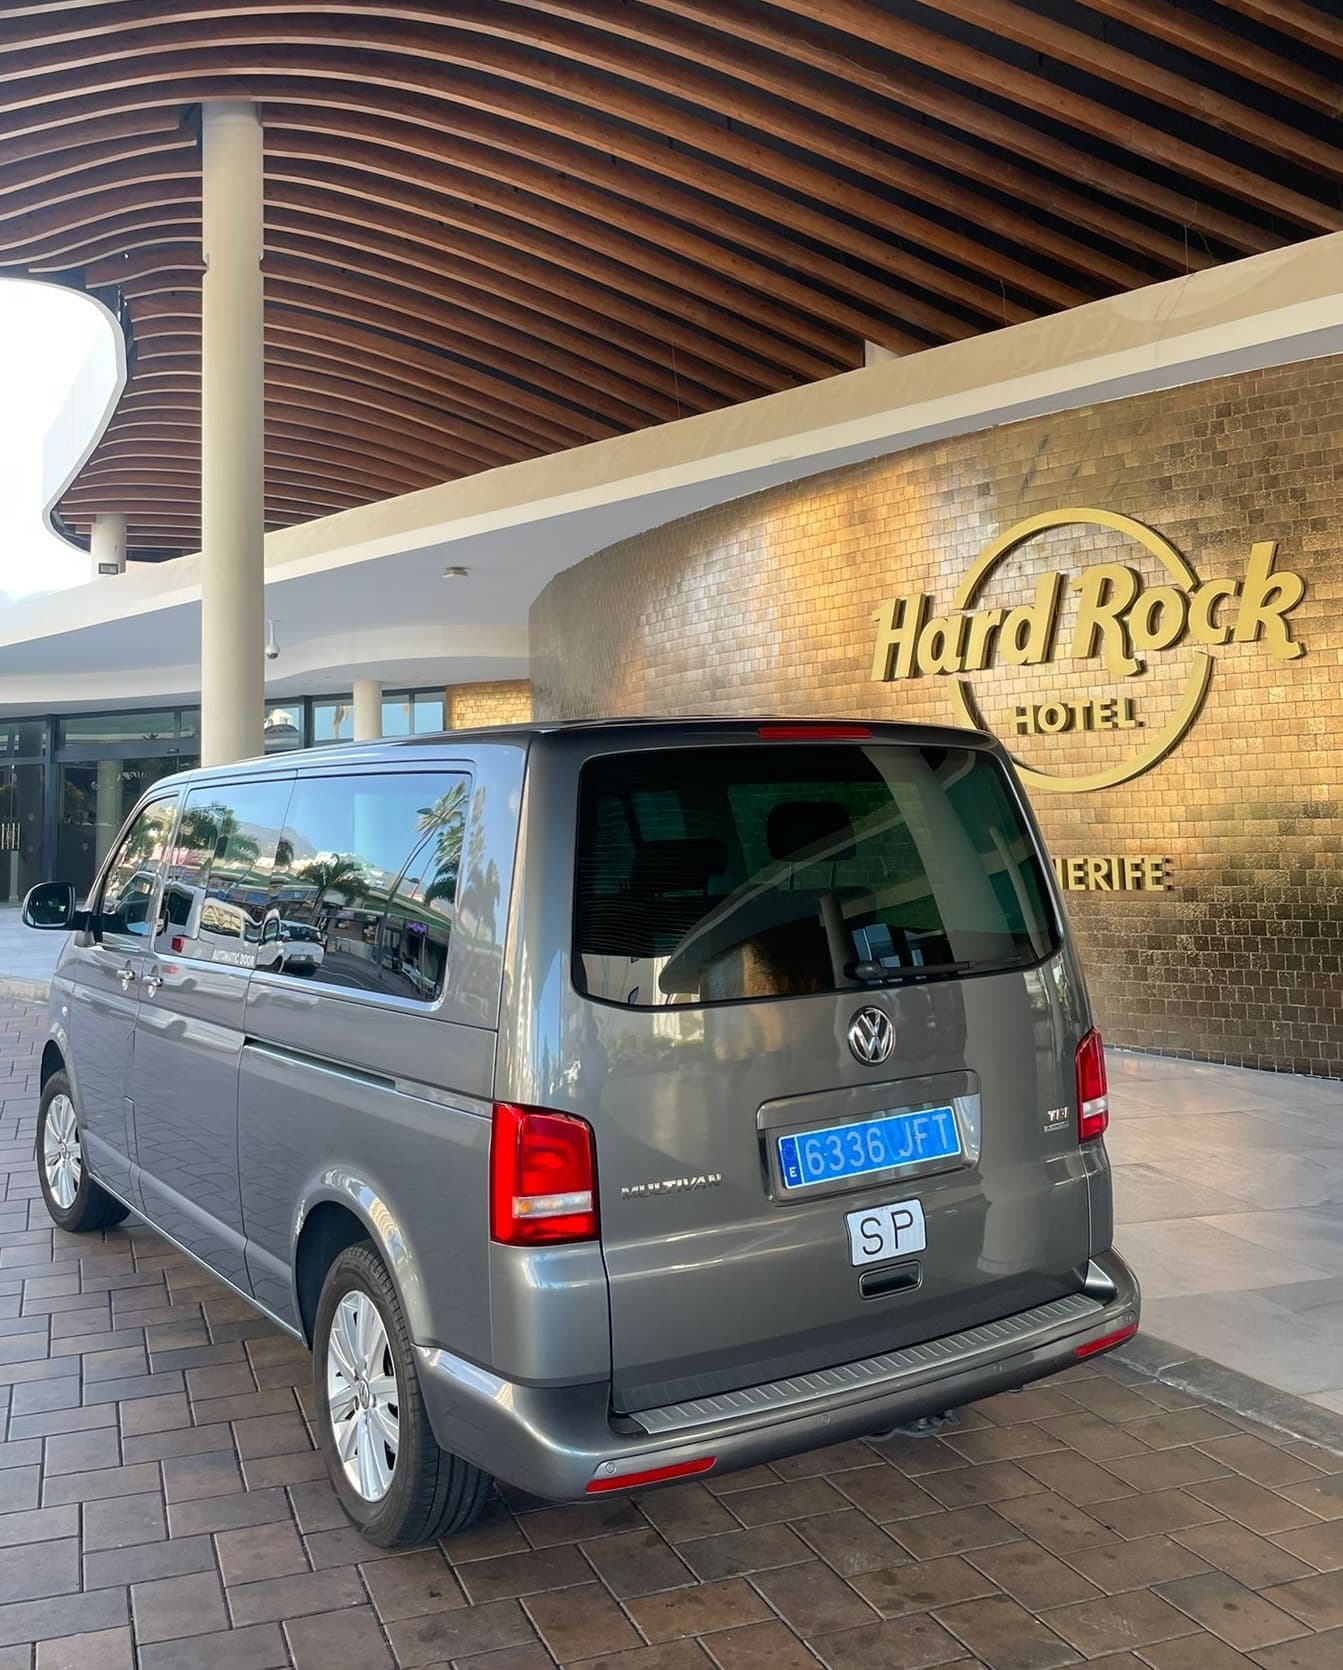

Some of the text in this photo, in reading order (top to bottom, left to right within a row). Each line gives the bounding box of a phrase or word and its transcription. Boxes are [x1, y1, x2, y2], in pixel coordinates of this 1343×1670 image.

[871, 541, 1306, 681] Hard Rock
[1009, 697, 1138, 735] HOTEL
[804, 1113, 948, 1176] 6336 JFT
[621, 1173, 722, 1200] MULTIVAN
[789, 1166, 798, 1178] E
[860, 1208, 914, 1255] SP
